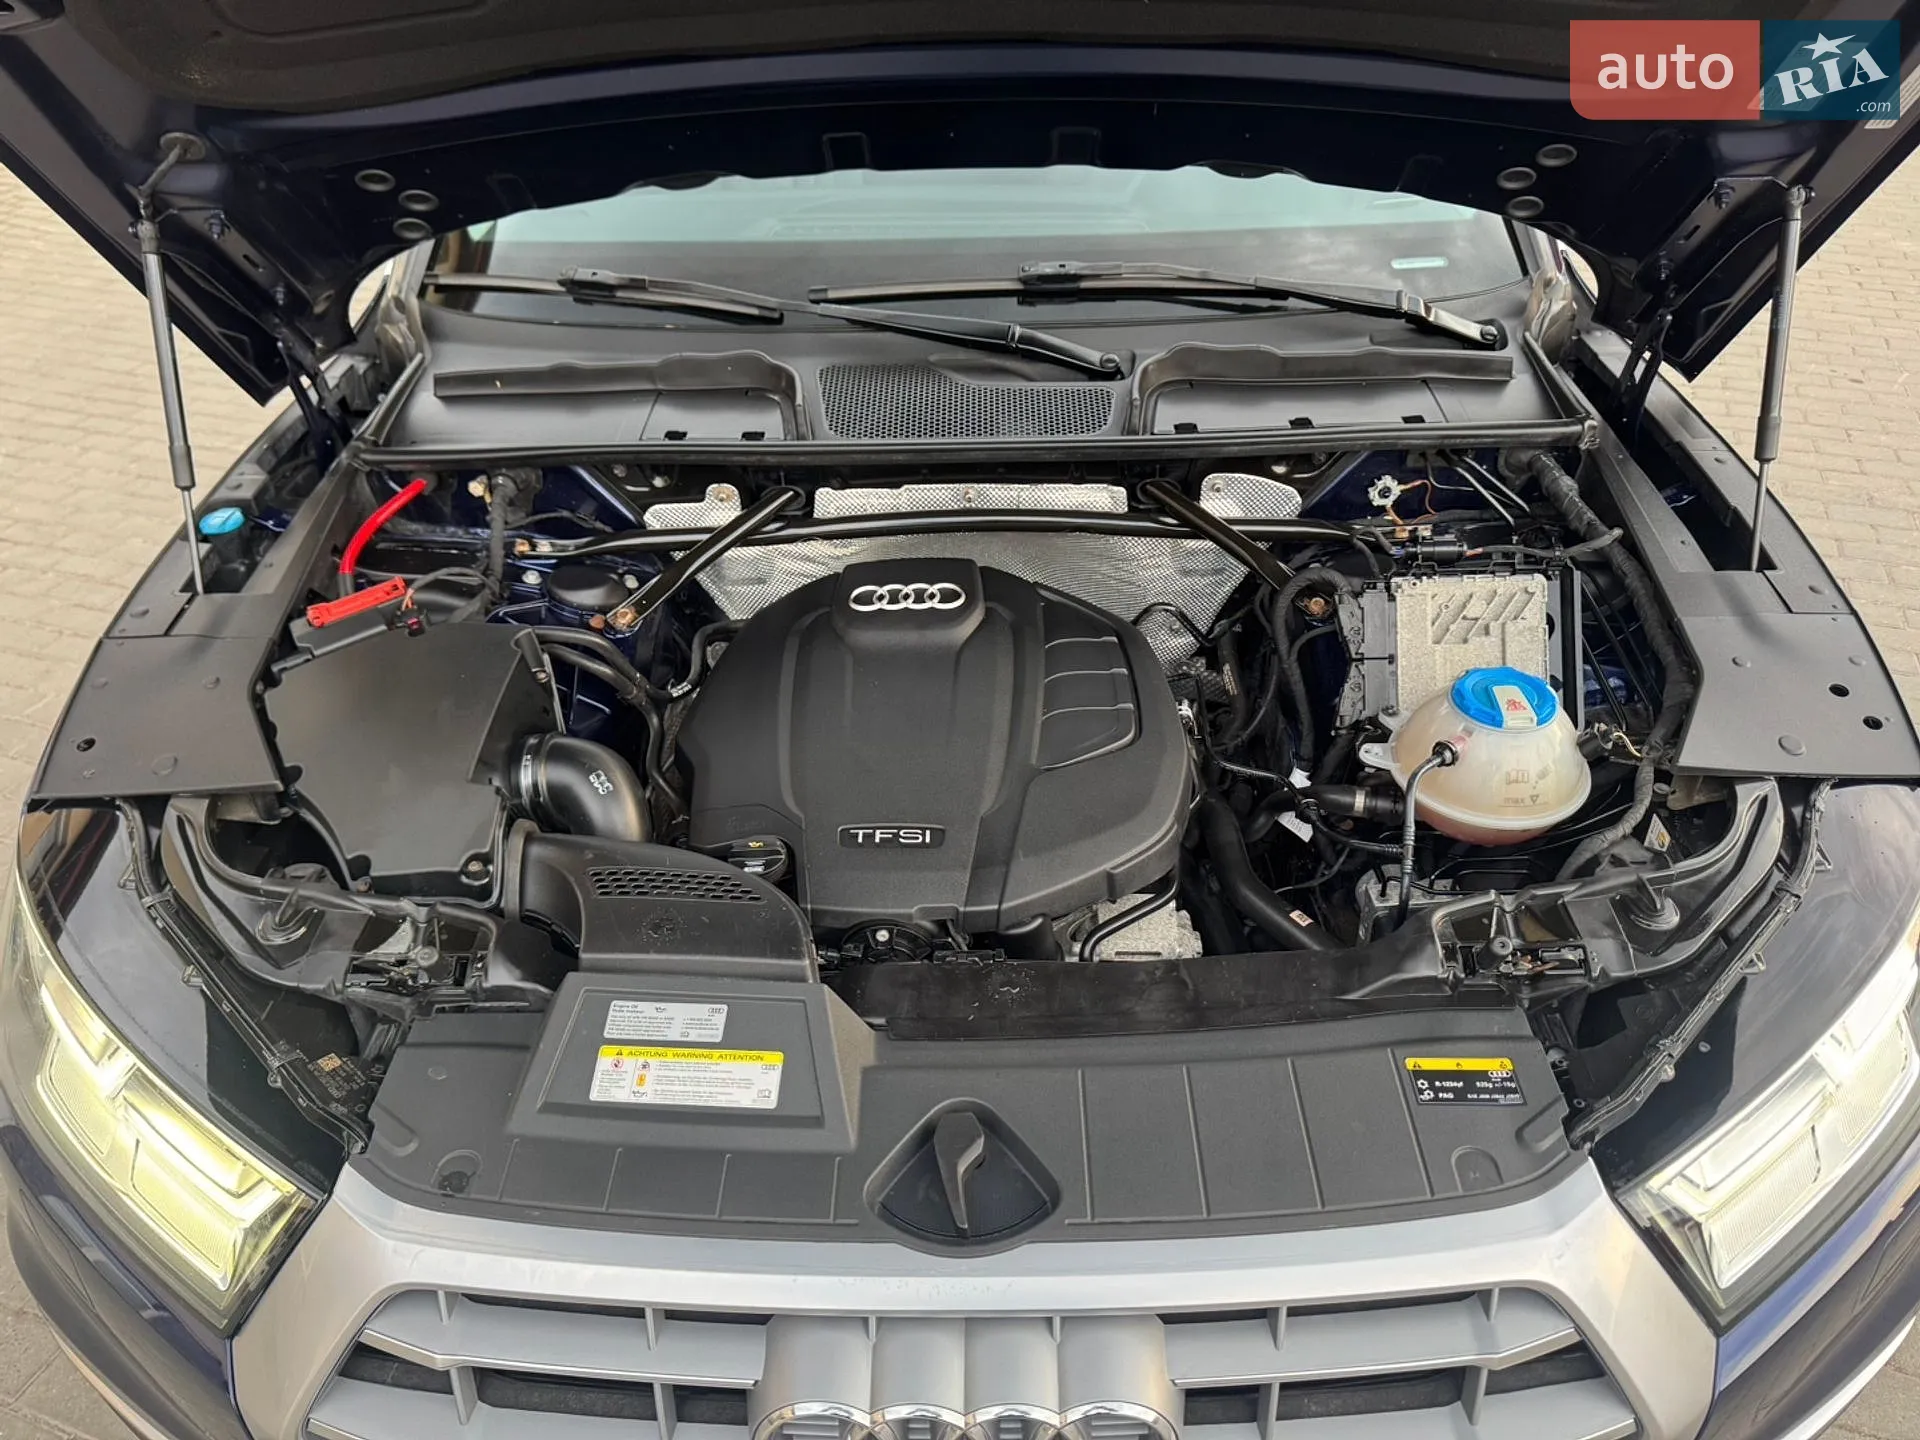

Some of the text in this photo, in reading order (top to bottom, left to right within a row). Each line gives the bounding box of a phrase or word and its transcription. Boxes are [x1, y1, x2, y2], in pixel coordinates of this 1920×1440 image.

[849, 829, 931, 843] TFSI
[672, 1052, 714, 1060] WARNING
[717, 1053, 765, 1061] ATTENTION
